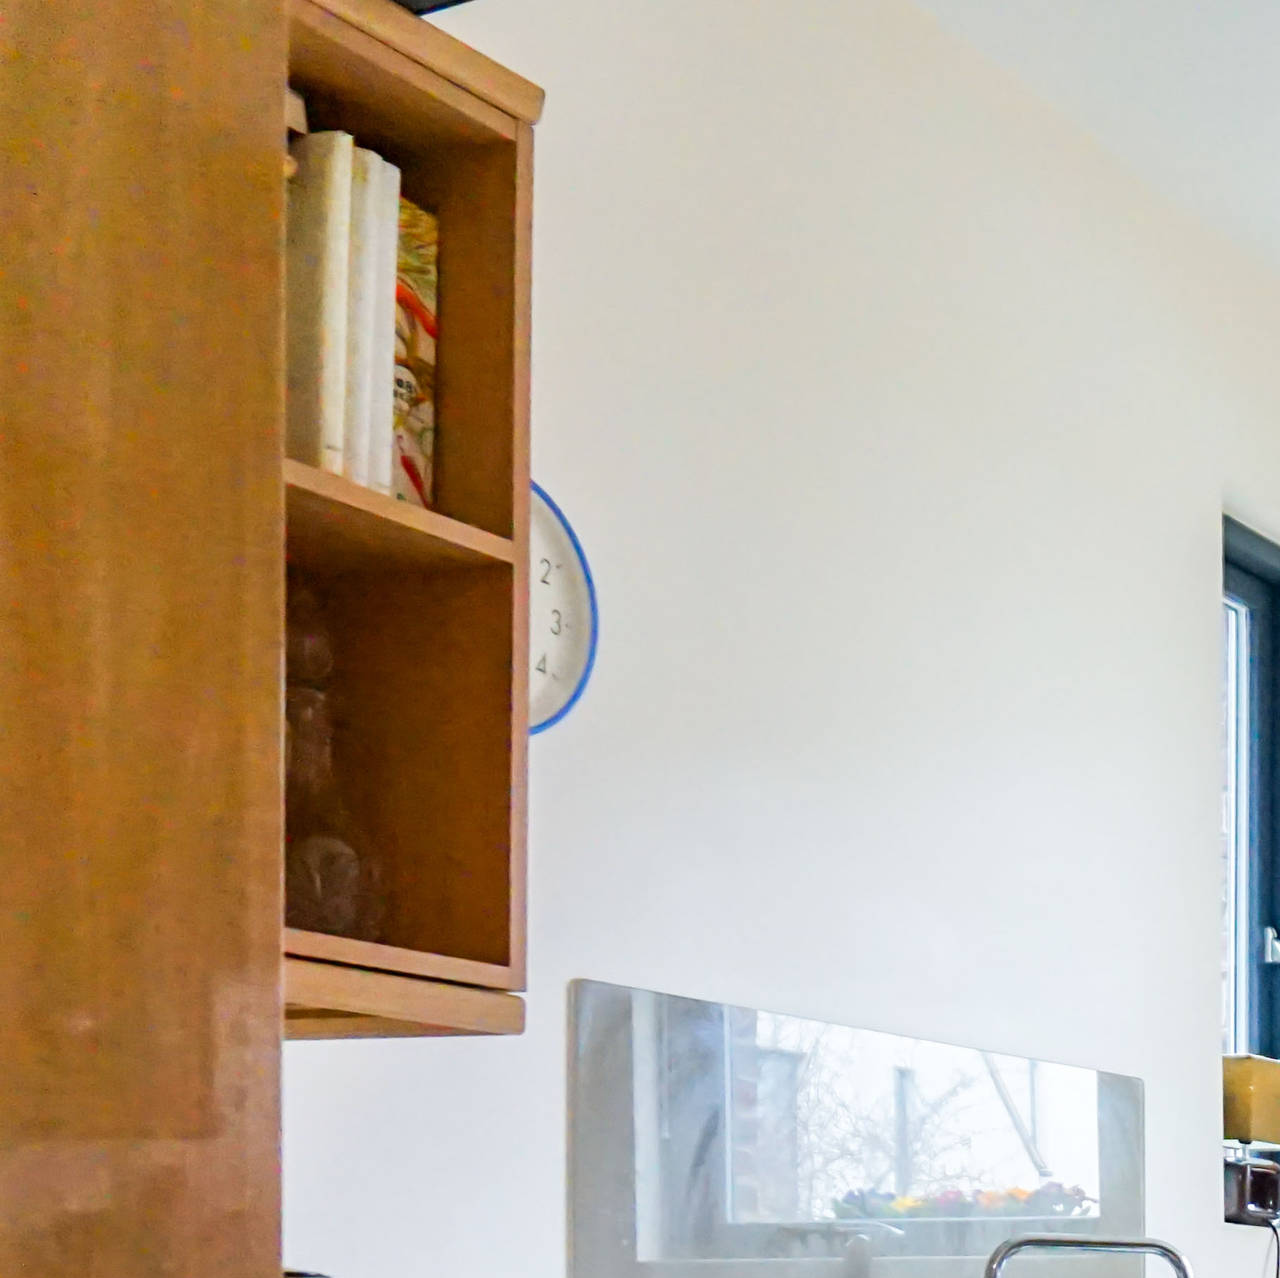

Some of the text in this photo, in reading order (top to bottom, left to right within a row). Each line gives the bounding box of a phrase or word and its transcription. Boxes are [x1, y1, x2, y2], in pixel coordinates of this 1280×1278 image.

[540, 558, 551, 585] 2
[550, 609, 562, 635] 3
[535, 653, 547, 674] 4
